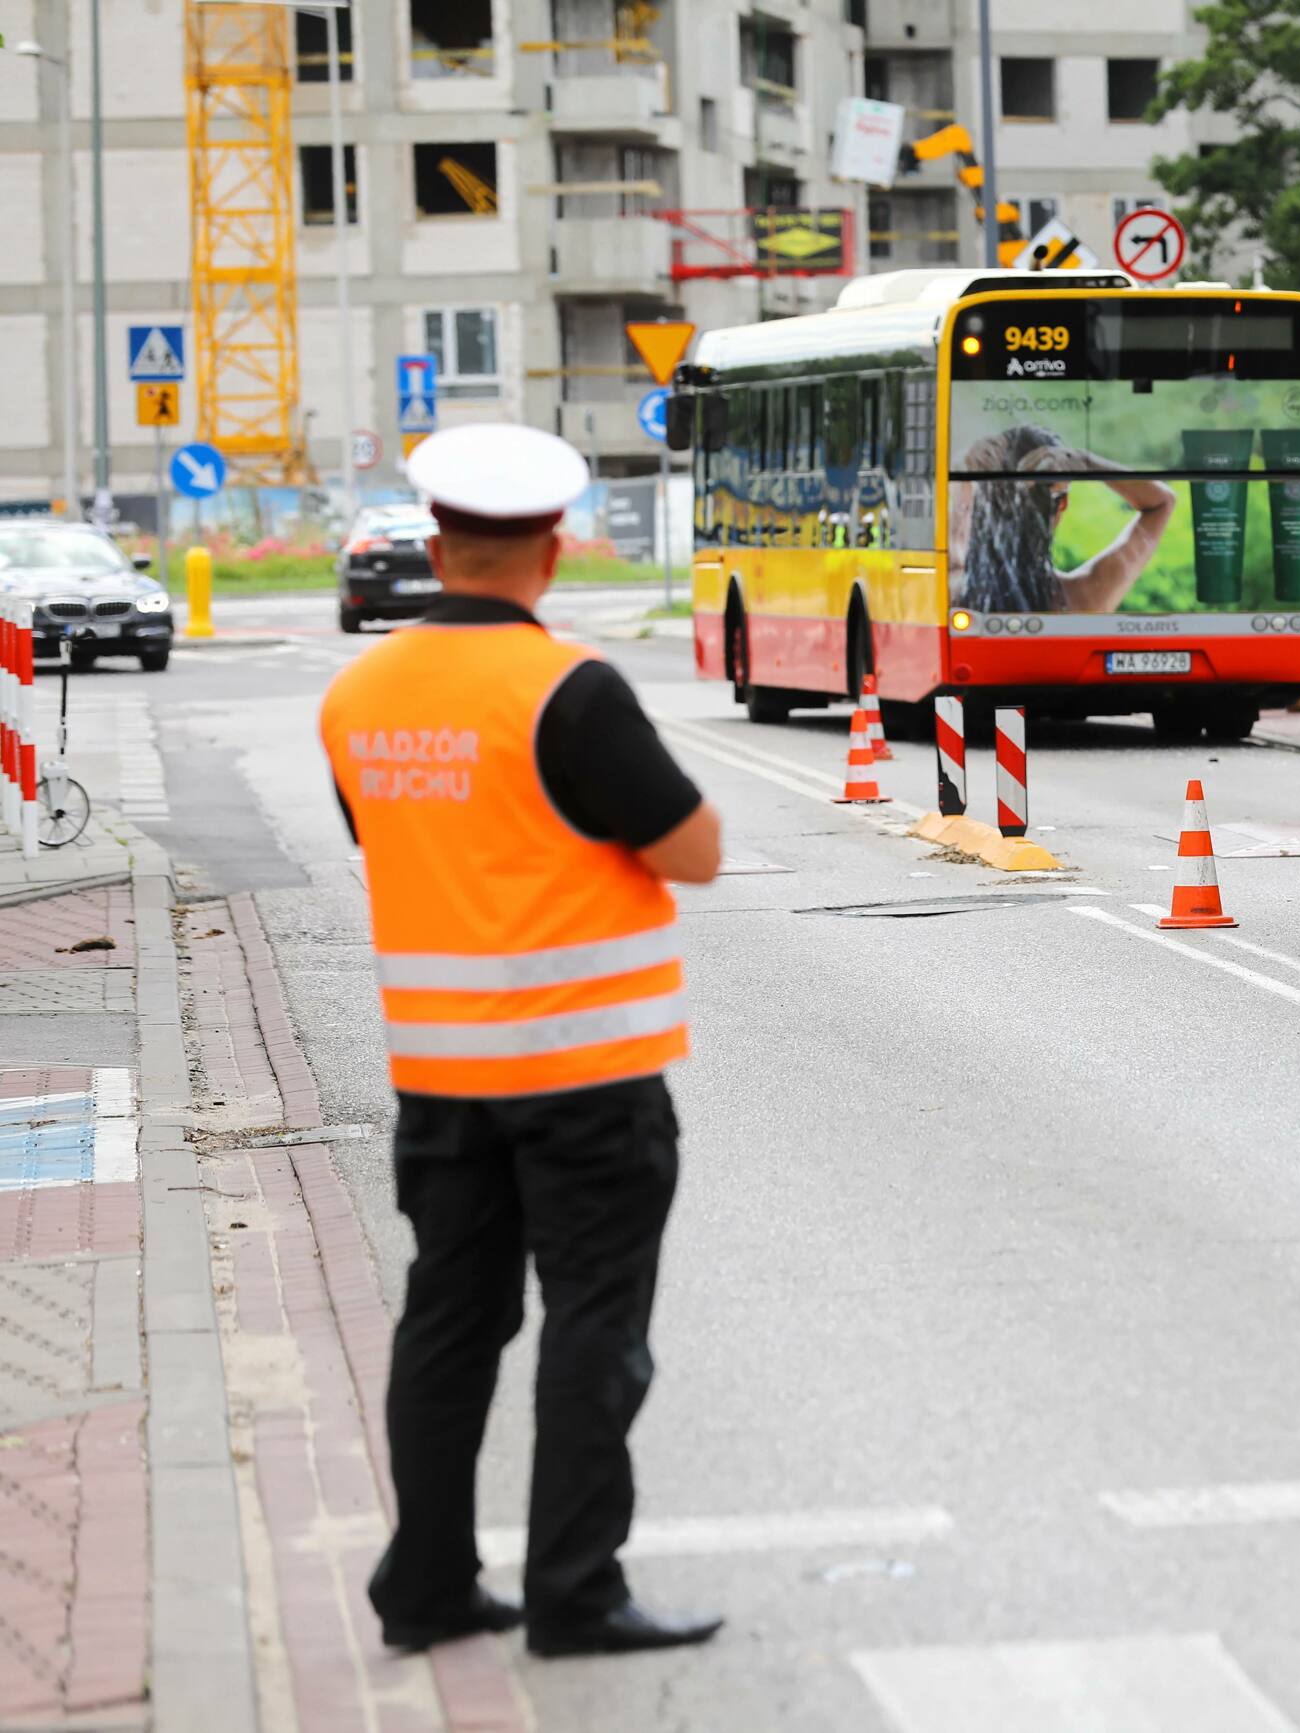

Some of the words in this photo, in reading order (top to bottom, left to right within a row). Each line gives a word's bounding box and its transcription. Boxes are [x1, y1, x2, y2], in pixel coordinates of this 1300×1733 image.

[1004, 325, 1070, 352] 9439
[1117, 621, 1180, 633] SOLARIS
[1115, 652, 1136, 668] WA
[1141, 652, 1187, 668] 96928
